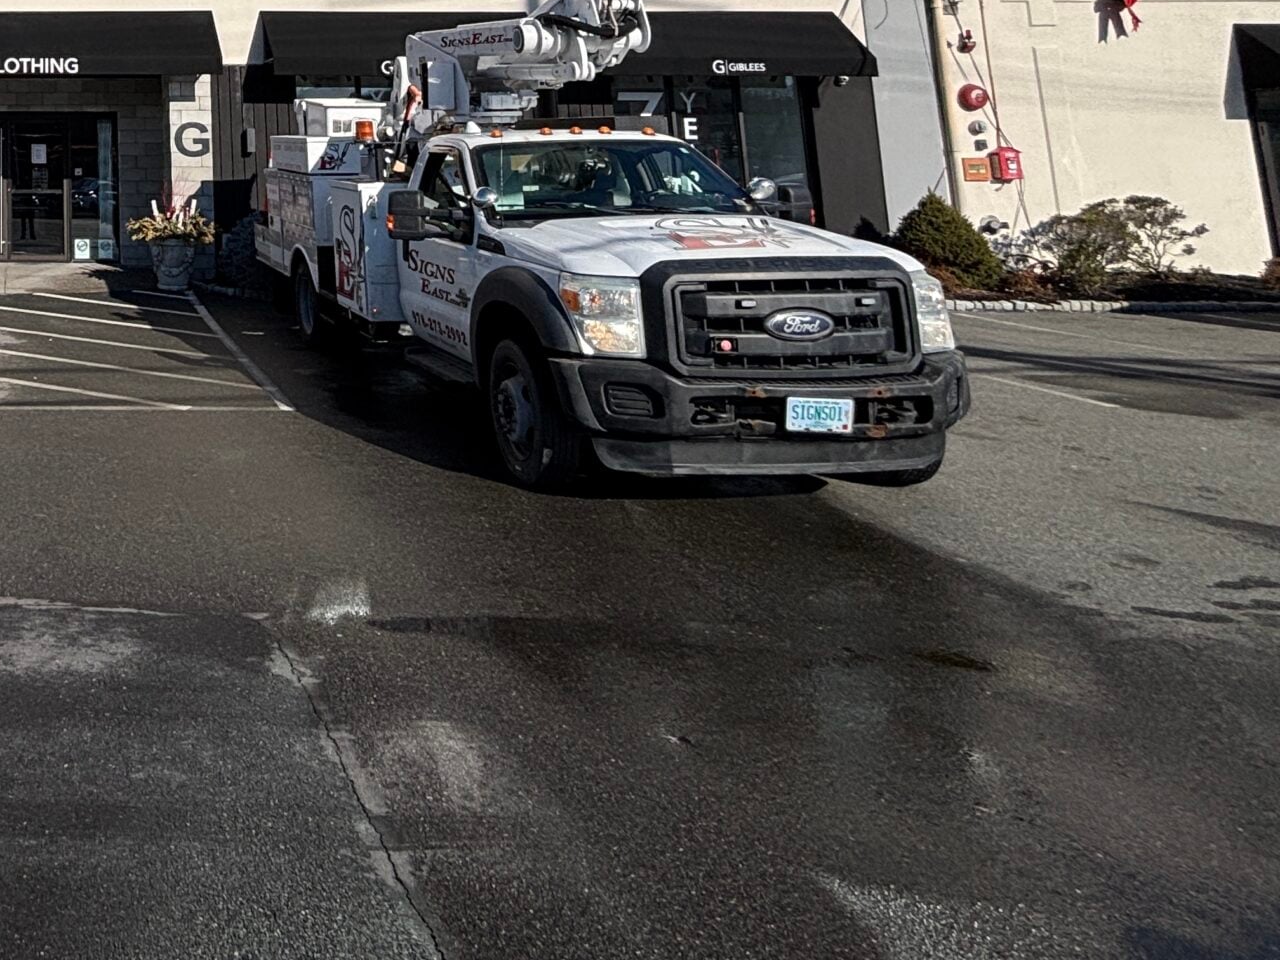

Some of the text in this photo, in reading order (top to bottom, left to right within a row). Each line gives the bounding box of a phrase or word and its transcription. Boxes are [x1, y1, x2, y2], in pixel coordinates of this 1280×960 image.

[728, 62, 766, 72] GIBLEES
[174, 121, 211, 157] G
[408, 248, 456, 285] SIGNS
[421, 277, 451, 302] EAST
[783, 316, 821, 334] Ford
